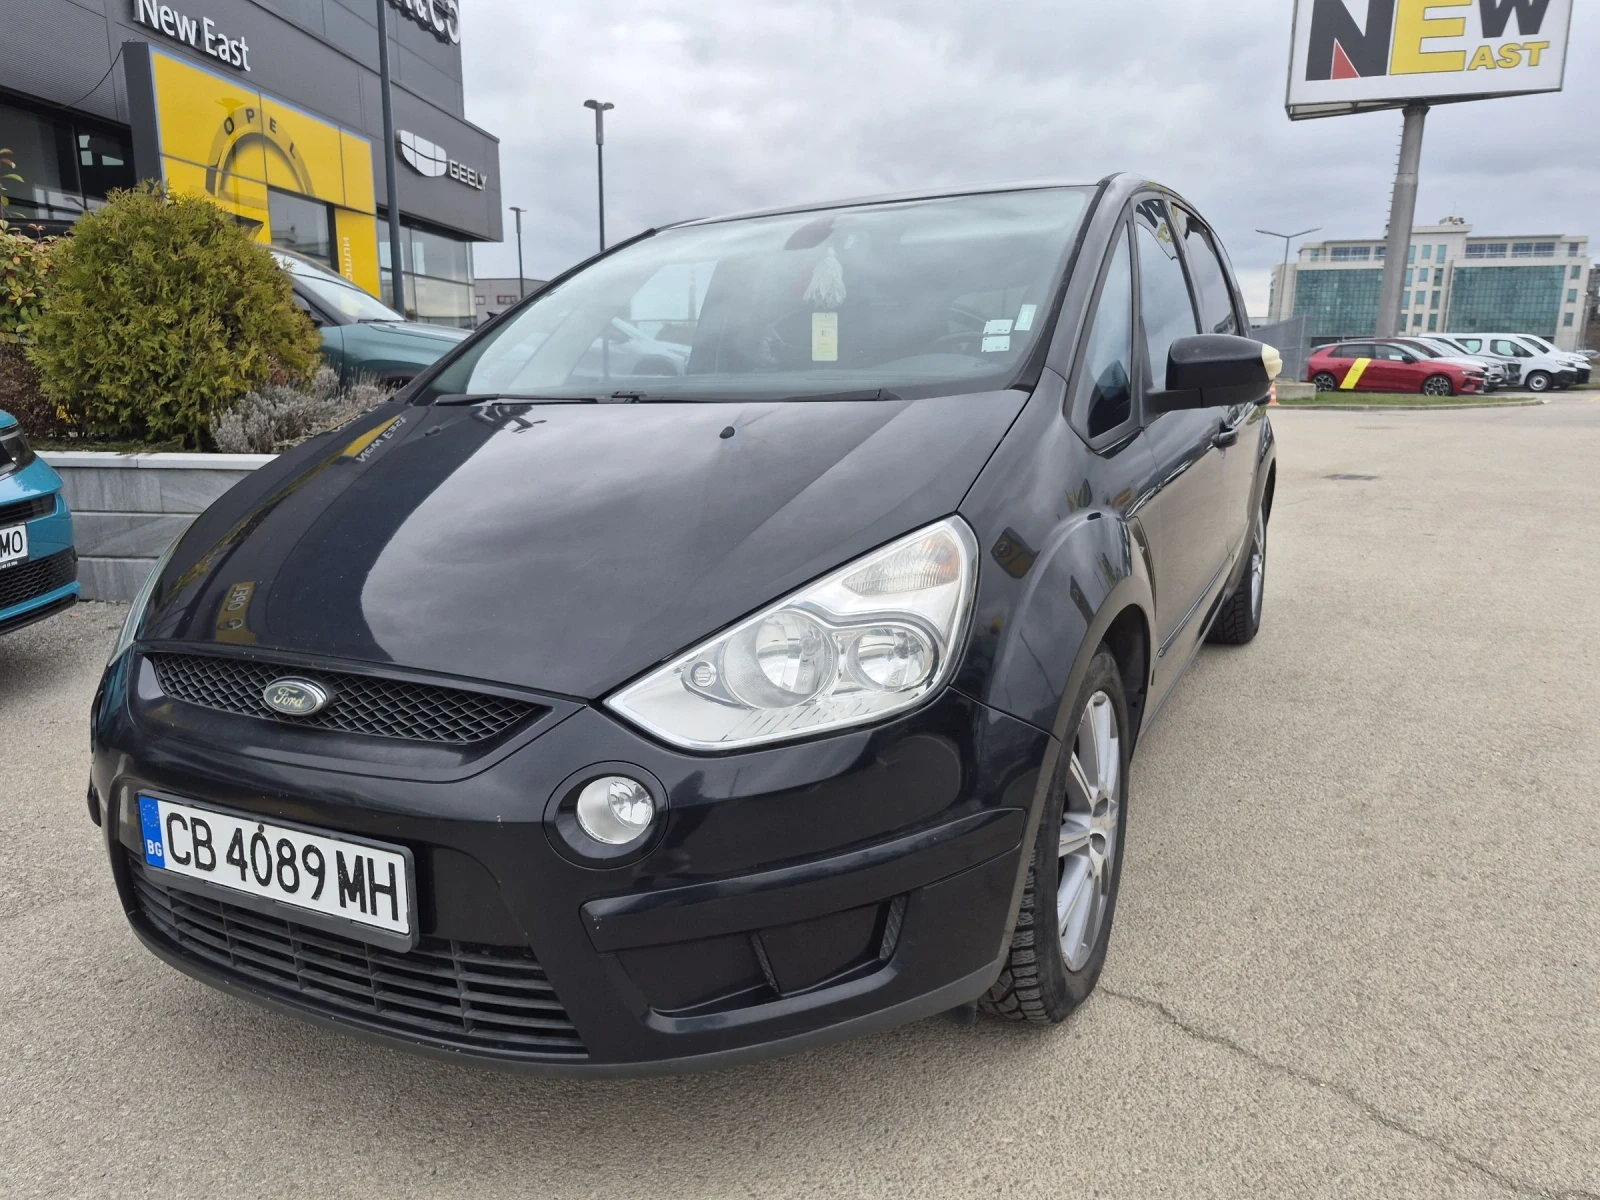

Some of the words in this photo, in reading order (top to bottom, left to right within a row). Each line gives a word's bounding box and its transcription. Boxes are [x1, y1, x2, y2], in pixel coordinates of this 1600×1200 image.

[139, 0, 196, 46] New
[203, 16, 251, 72] East
[1305, 0, 1550, 81] NEW
[223, 108, 296, 160] OPEL
[449, 159, 487, 191] GEELY
[273, 686, 306, 707] Ford
[147, 839, 163, 857] BG
[166, 812, 217, 872] CB
[226, 827, 326, 901] 4089
[336, 850, 399, 922] MH
